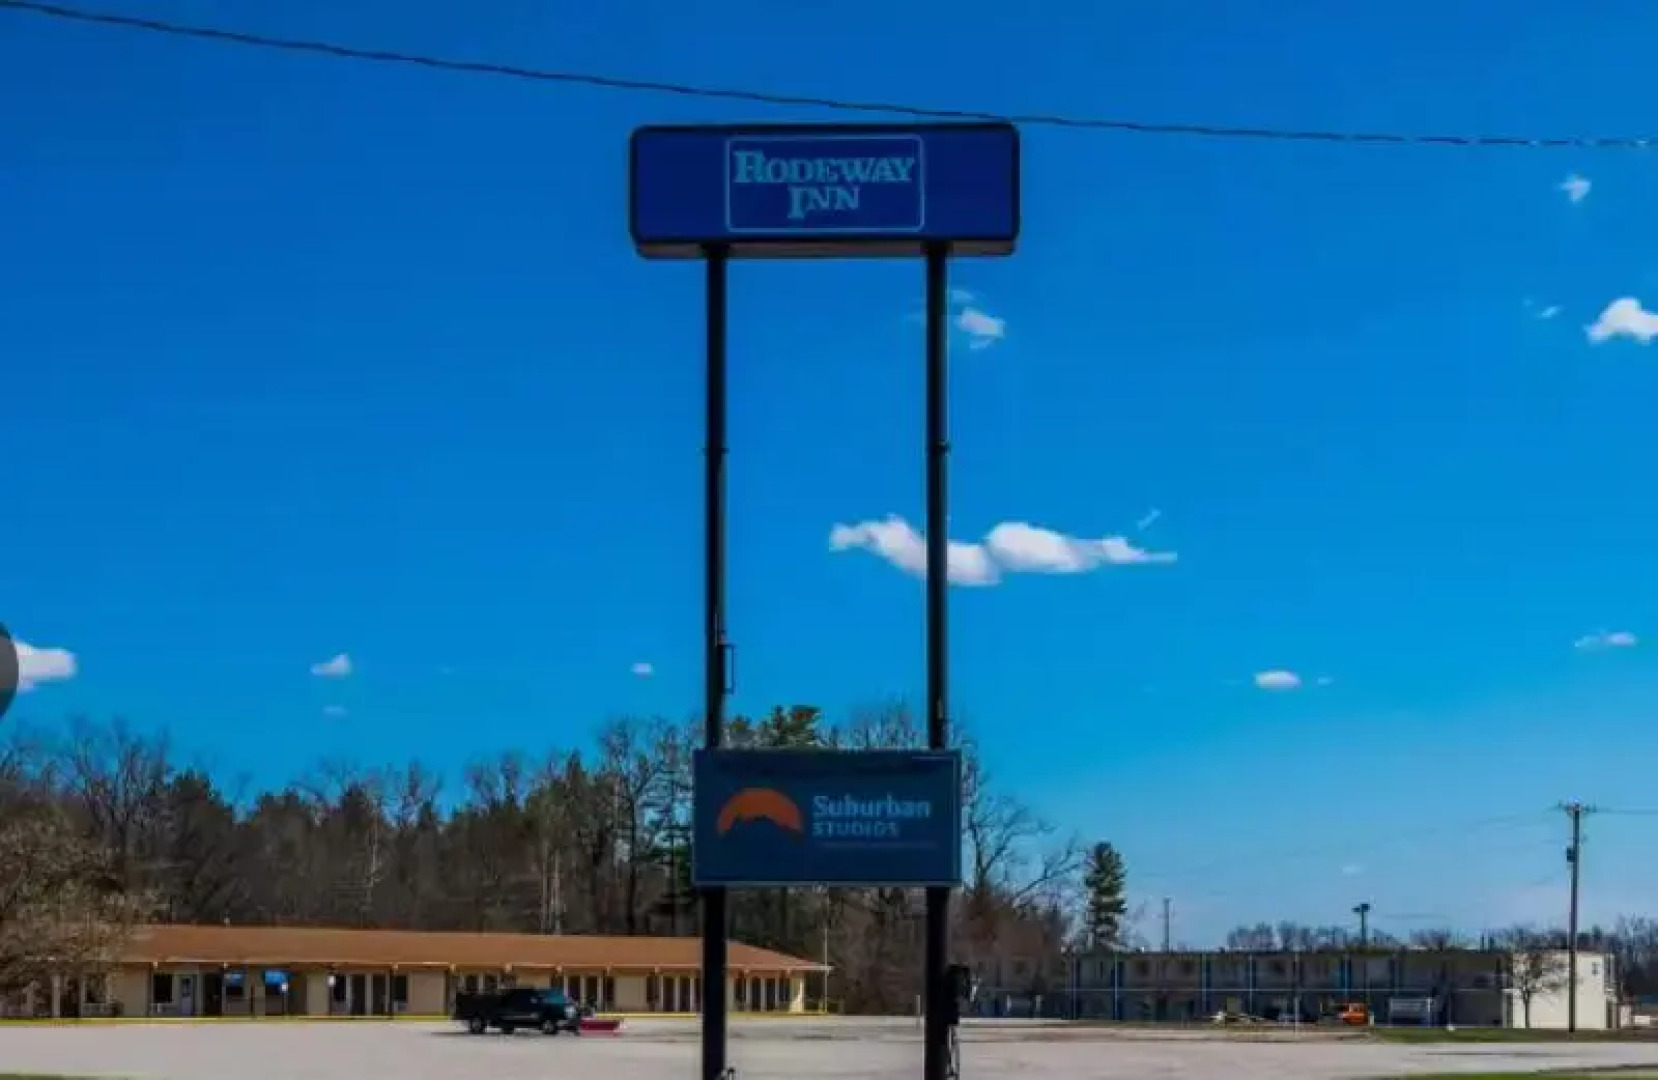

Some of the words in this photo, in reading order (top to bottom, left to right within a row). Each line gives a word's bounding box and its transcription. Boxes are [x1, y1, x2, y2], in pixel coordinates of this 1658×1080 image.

[733, 149, 915, 183] RODEWAY
[787, 185, 860, 220] INN
[812, 794, 931, 818] Suburban
[812, 821, 899, 837] STUDIOS
